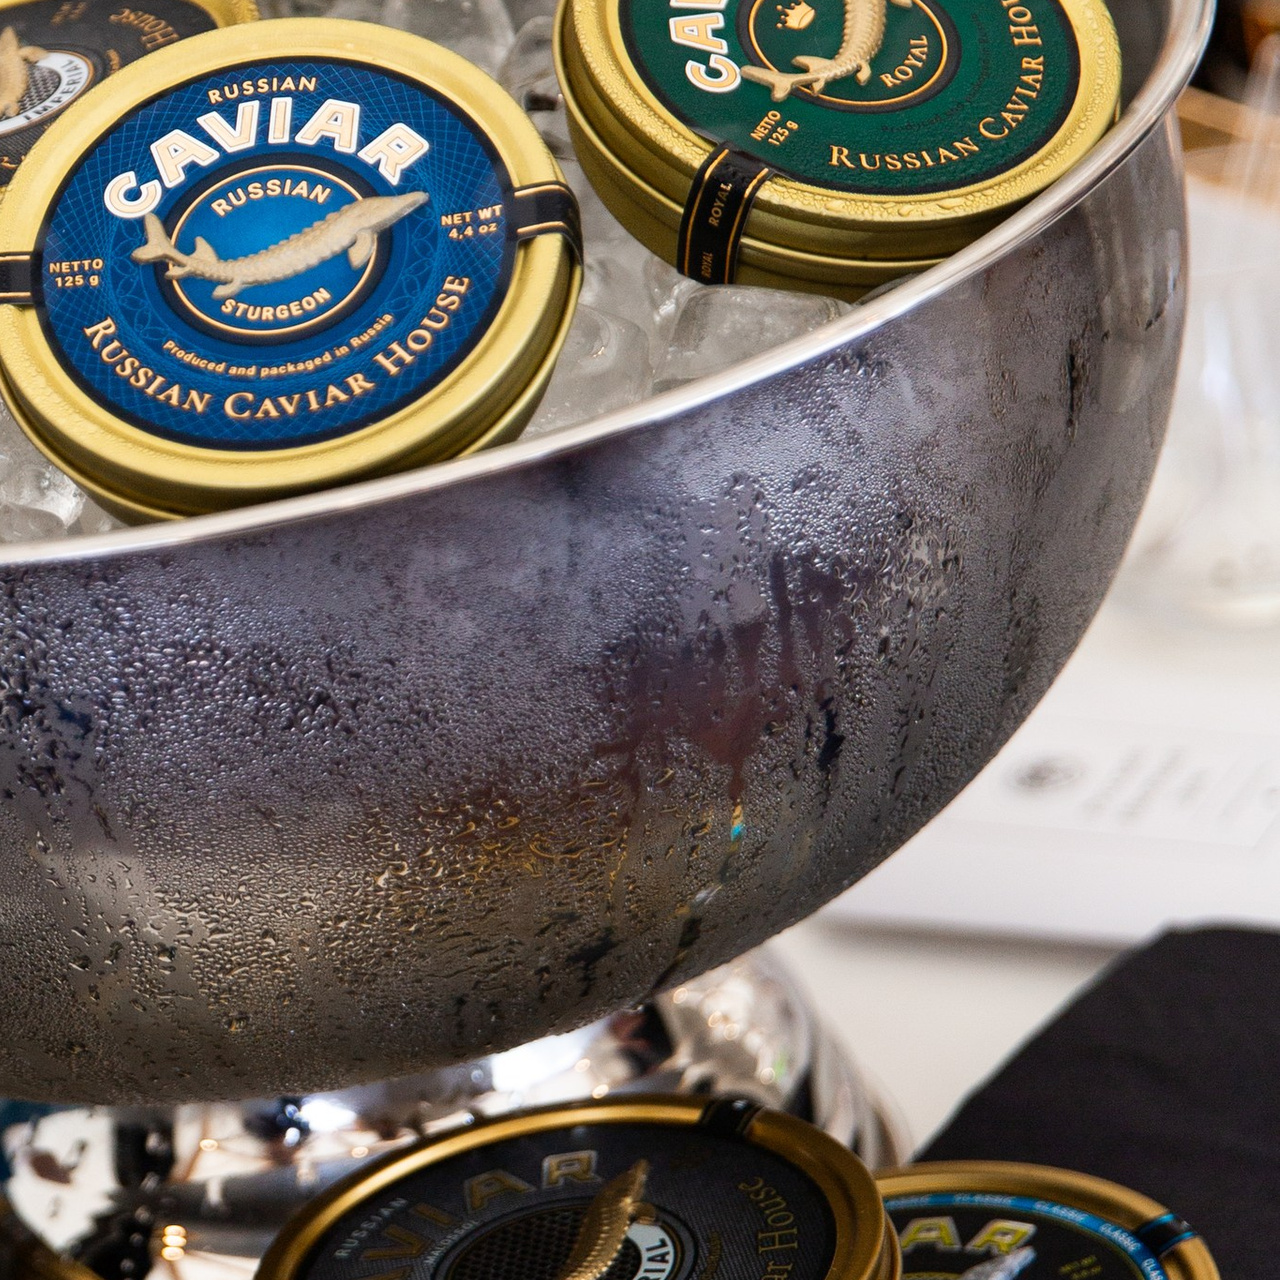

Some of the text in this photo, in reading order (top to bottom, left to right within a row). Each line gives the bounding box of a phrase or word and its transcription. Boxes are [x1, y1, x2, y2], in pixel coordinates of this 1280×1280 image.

[880, 35, 929, 88] ROYAL
[21, 57, 84, 122] IMPERIAL
[208, 76, 318, 104] RUSSIAN
[750, 110, 781, 141] NETTO
[828, 136, 980, 171] RUSSIAN
[978, 55, 1044, 139] CAVIAR
[768, 127, 790, 146] 125
[103, 96, 431, 218] CAVIAR
[211, 178, 332, 217] RUSSIAN
[441, 204, 504, 227] NET WT
[708, 182, 732, 228] ROYAL
[479, 222, 499, 234] oz
[49, 257, 104, 274] NETTO
[54, 275, 85, 289] 125
[221, 287, 332, 321] STURGEON
[84, 275, 471, 420] RUSSIAN CAVIAR HOUSE
[162, 313, 395, 380] Produced and packaged in Russia
[333, 1196, 410, 1261] RUSSIAN
[736, 1176, 801, 1255] House
[1100, 1222, 1142, 1252] CLASSIC
